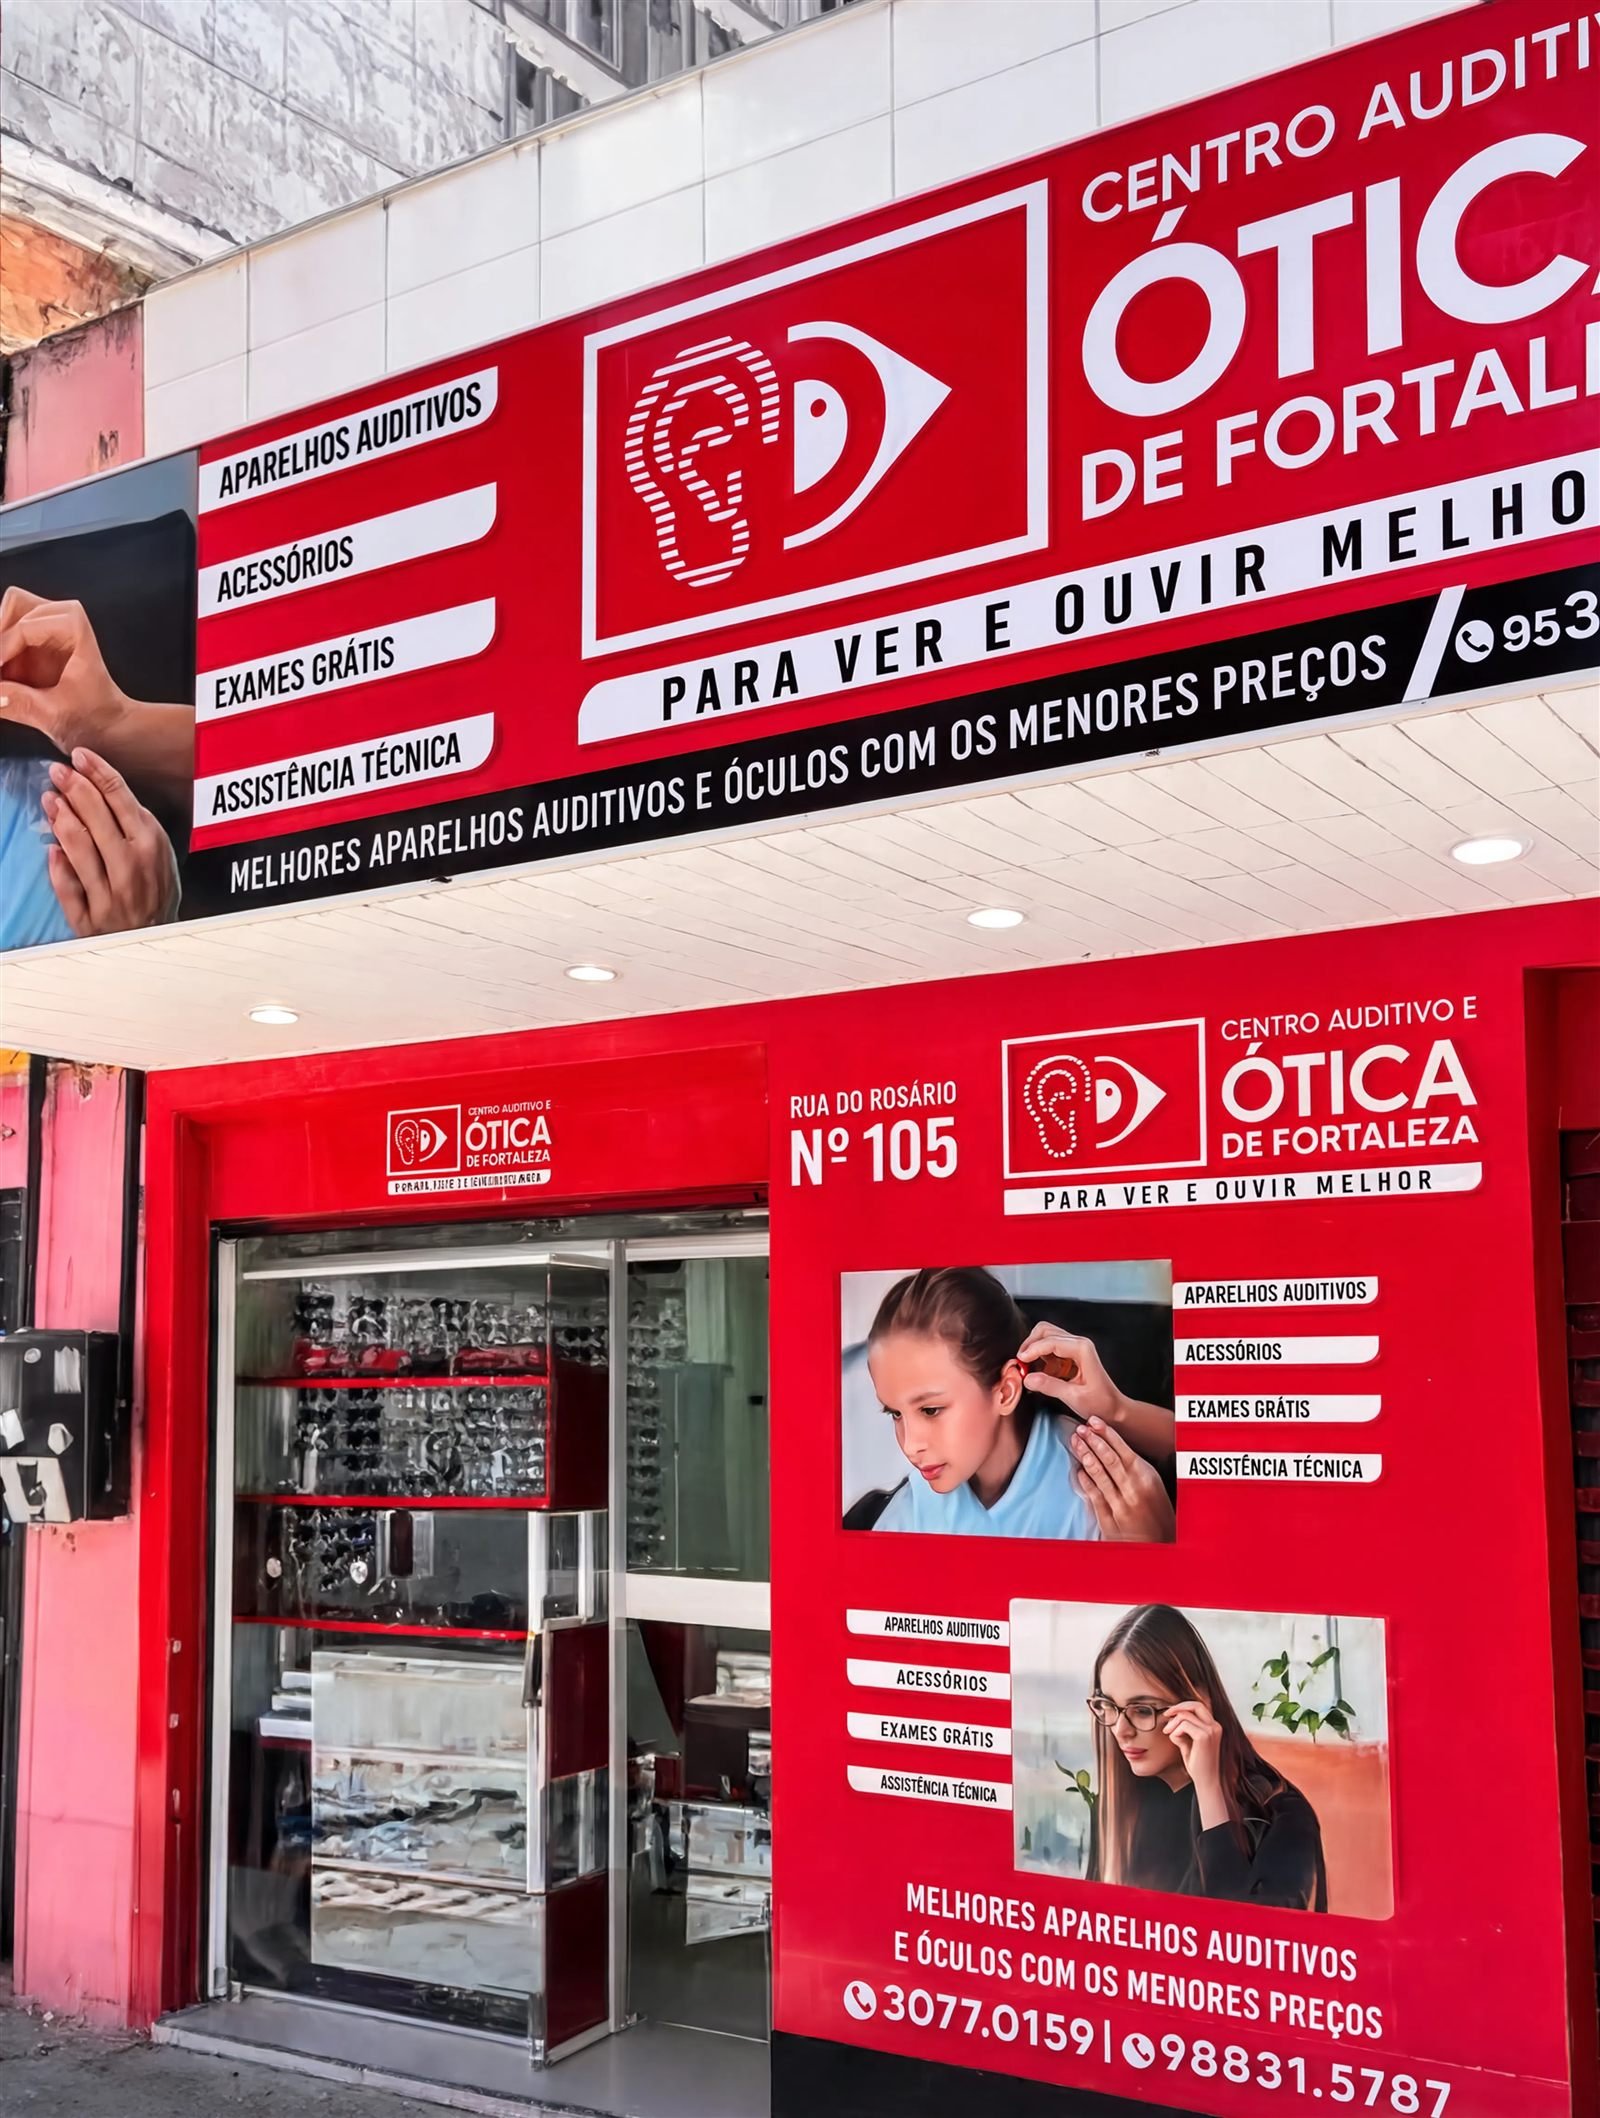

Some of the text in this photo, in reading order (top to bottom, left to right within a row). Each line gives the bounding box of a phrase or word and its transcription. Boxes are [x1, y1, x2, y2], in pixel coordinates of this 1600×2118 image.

[1082, 12, 1600, 223] CENTRO AUDITI
[1081, 130, 1600, 417] ÓTIC
[219, 381, 482, 499] APARELHOS AUDITIVOS
[1082, 429, 1183, 521] DE
[217, 535, 354, 603] ACESSÓRIOS
[663, 650, 799, 721] PARA
[834, 618, 944, 684] VER
[985, 600, 1011, 652] E
[1055, 544, 1266, 635] OUVIR
[1502, 590, 1600, 652] 953
[215, 636, 395, 710] EXAMES GRÁTIS
[211, 732, 461, 816] ASSISTÊNCIA TÉCNICA
[230, 634, 1387, 894] MELHORES APARELHOS AUDITIVOS E ÓCULOS COM OS MENORES PREÇOS
[1221, 995, 1477, 1041] CENTRO AUDITIVO E
[790, 1079, 957, 1119] RUA DO ROSÁRIO
[1221, 1038, 1478, 1123] ÓTICA
[465, 1115, 552, 1151] ÓTICA
[468, 1100, 551, 1116] CENTRO AUDITIVO E
[466, 1149, 551, 1168] DE FORTALEZA
[863, 1116, 958, 1182] 105
[1222, 1115, 1479, 1159] DE FORTALEZA
[1044, 1170, 1432, 1210] PARA VER E OUVIR MELHOR
[1184, 1281, 1367, 1305] APARELHOS AUDITIVOS
[1185, 1342, 1282, 1362] ACESSÓRIOS
[1188, 1399, 1310, 1419] EXAMES GRÁTIS
[1188, 1454, 1363, 1479] ASSISTÊNCIA TÉCNICA
[884, 1616, 1000, 1640] APARELHOS AUDITIVOS
[896, 1669, 988, 1692] ACESSÓRIOS
[881, 1721, 994, 1748] EXAMES GRÁTIS
[880, 1774, 997, 1803] ASSISTÊNCIA TÉCNICA
[907, 1882, 1357, 1982] MELHORES APARELHOS AUDITIVOS
[894, 1929, 1383, 2040] E ÓCULOS COM OS MENORES PREÇOS
[883, 1984, 1451, 2118] 3077.0159 98831.5787
